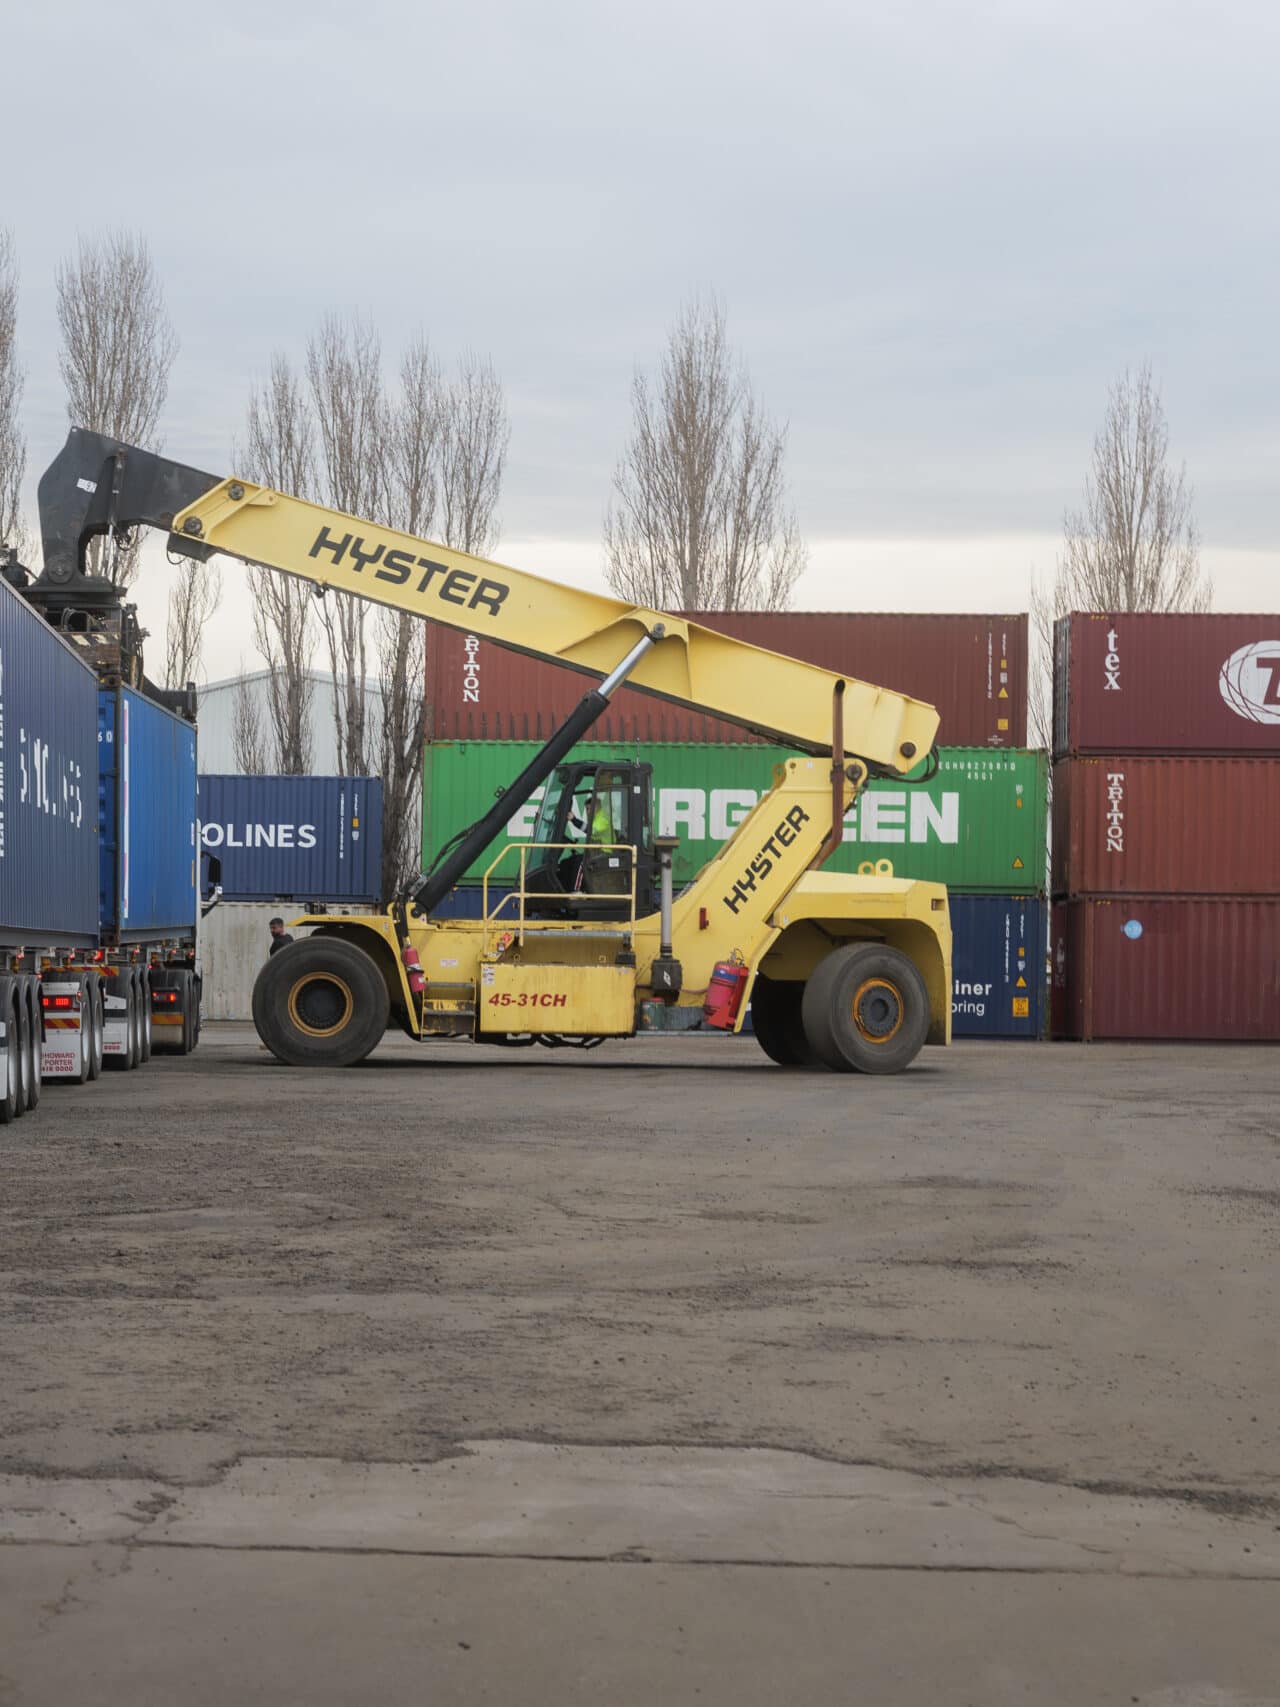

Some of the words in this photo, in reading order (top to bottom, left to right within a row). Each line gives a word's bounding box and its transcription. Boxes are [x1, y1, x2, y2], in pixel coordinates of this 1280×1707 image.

[308, 526, 510, 616] HYSTER
[463, 635, 480, 702] RITON
[1104, 629, 1121, 690] tex
[201, 822, 317, 848] OLINES
[507, 785, 960, 844] EVRGEN
[1106, 773, 1124, 852] TRITON
[722, 804, 810, 915] HYSTER
[488, 993, 567, 1007] 45-31CH
[951, 979, 993, 996] iner
